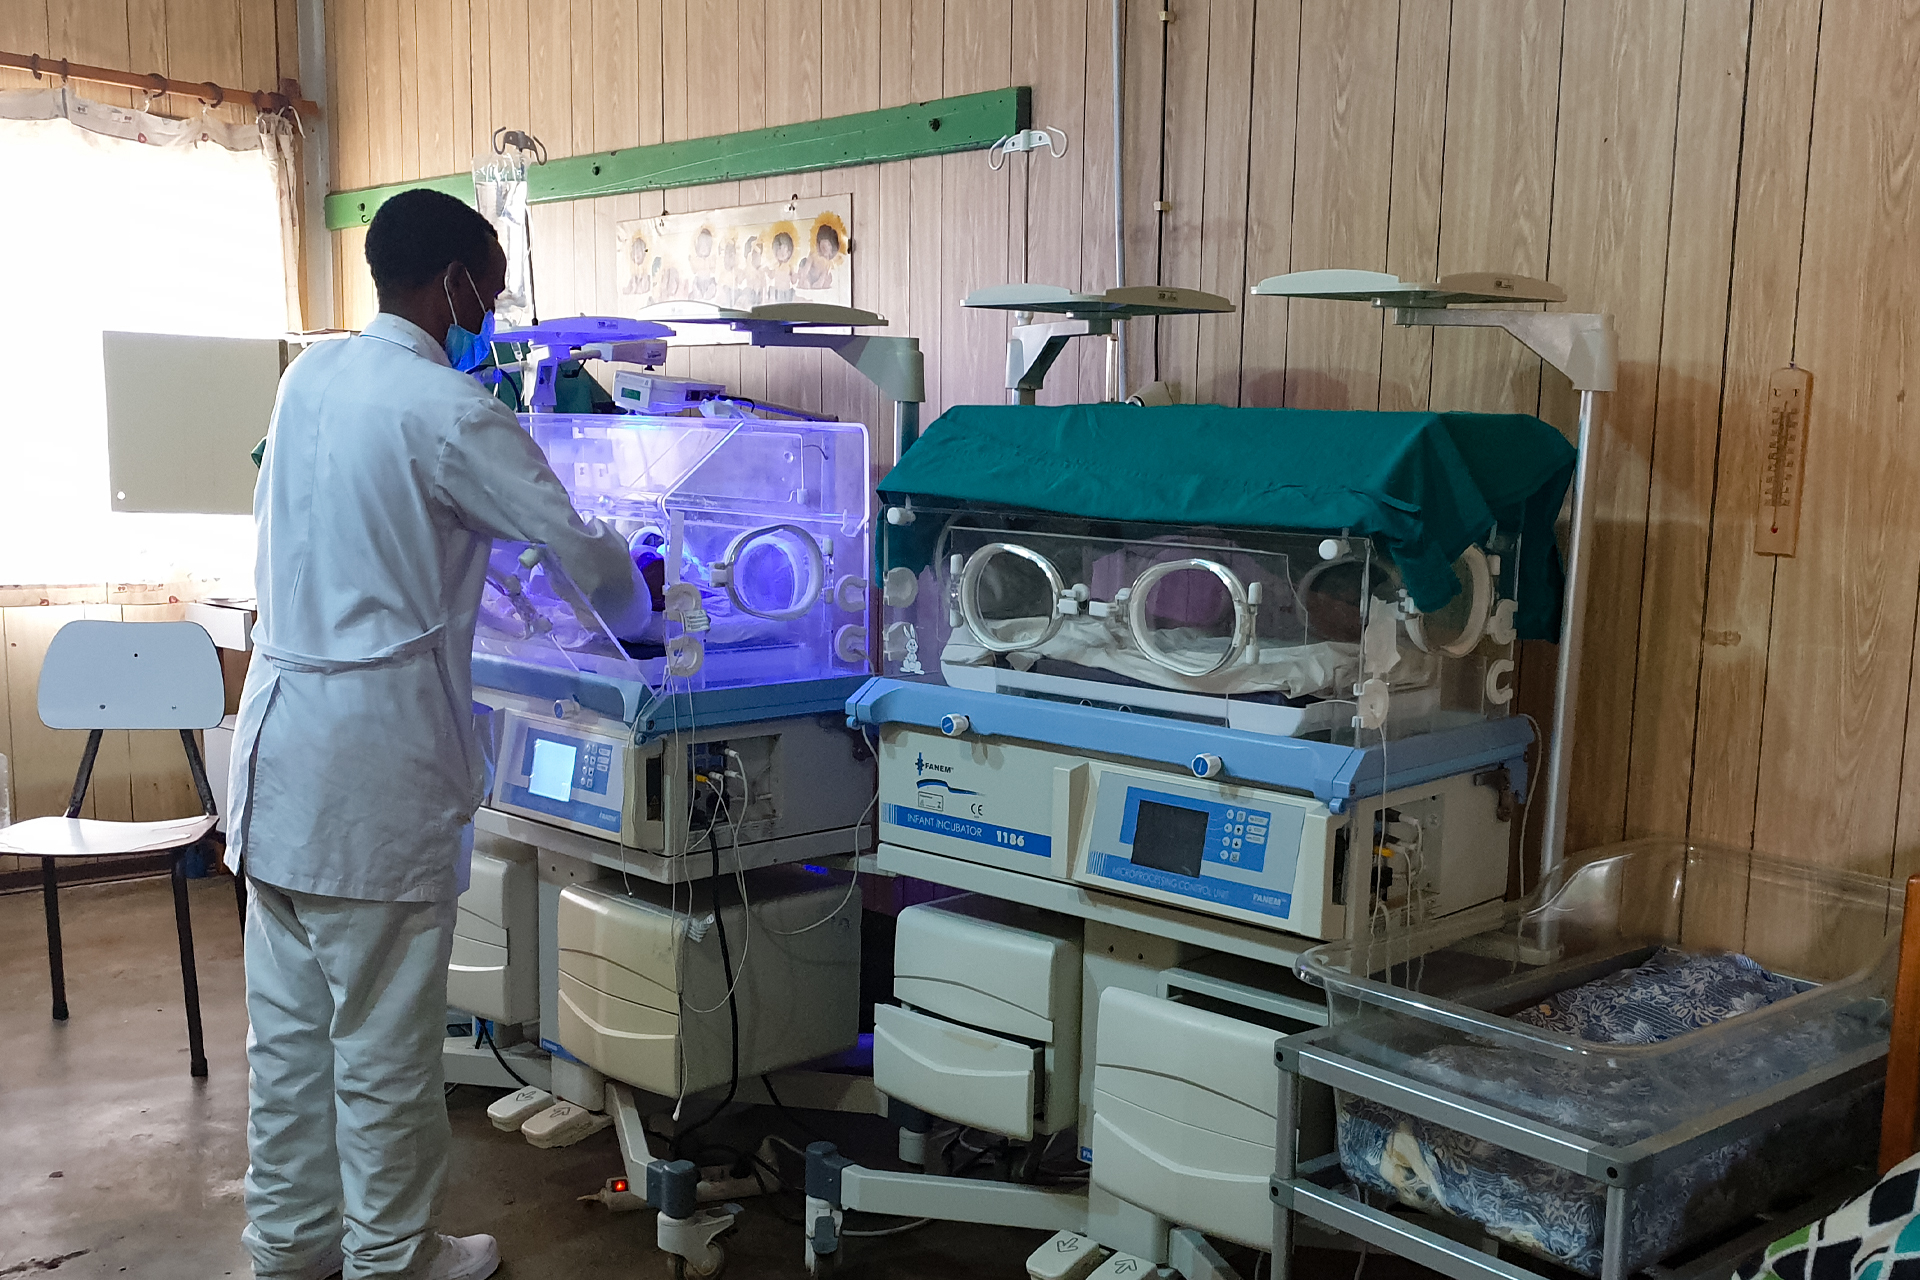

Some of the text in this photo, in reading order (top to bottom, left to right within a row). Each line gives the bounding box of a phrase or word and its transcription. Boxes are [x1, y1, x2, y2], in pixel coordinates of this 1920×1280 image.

[925, 762, 952, 774] FANEM
[907, 813, 1025, 848] INFANT INCUBATOR 1186
[1252, 893, 1281, 907] FANEM
